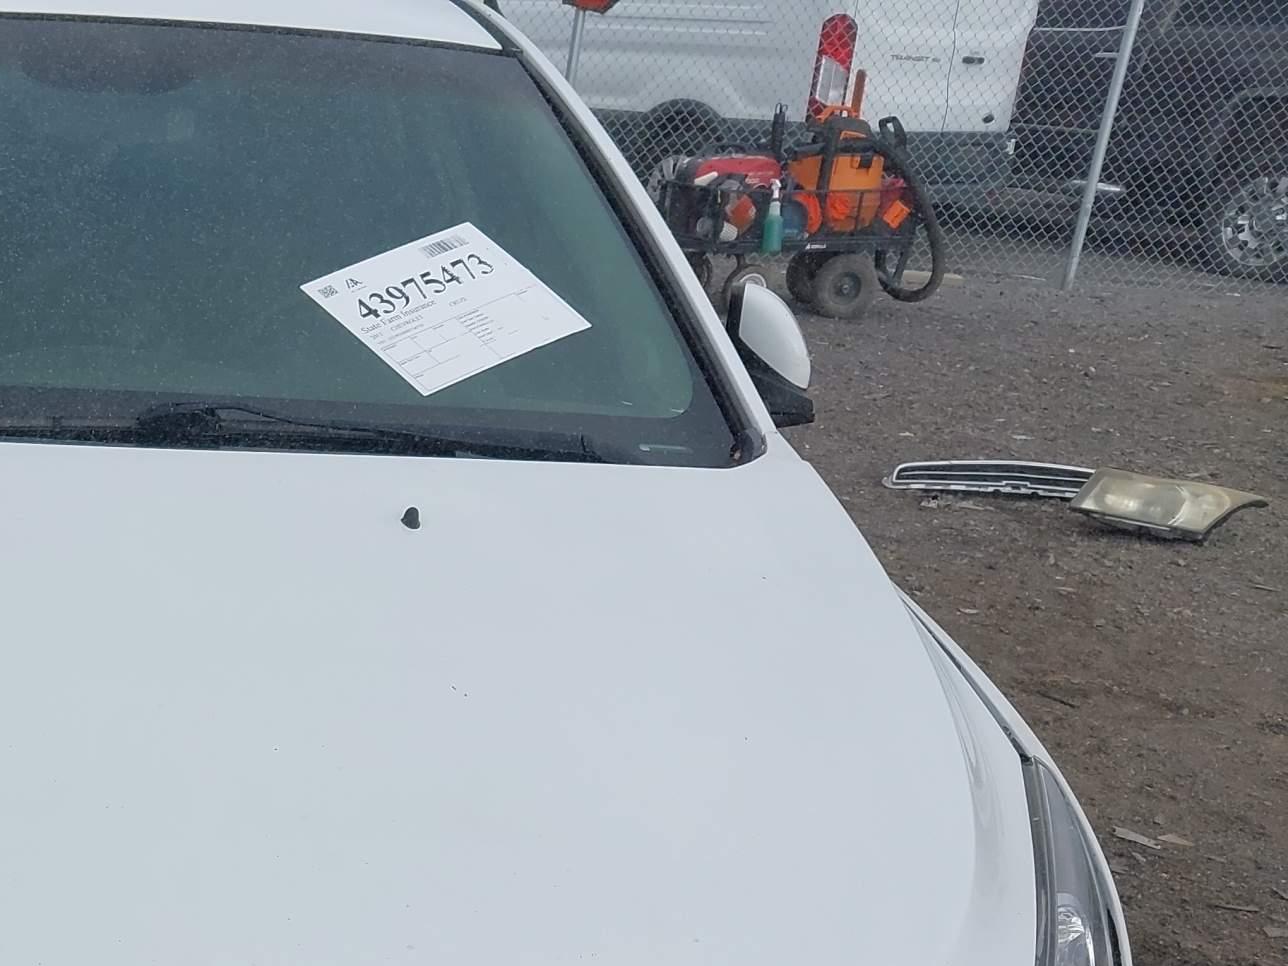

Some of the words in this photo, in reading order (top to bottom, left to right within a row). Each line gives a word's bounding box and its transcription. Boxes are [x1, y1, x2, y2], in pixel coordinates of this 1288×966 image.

[357, 252, 495, 320] 43975473
[360, 321, 382, 335] State
[380, 314, 402, 326] Farm
[401, 299, 437, 317] Insurance
